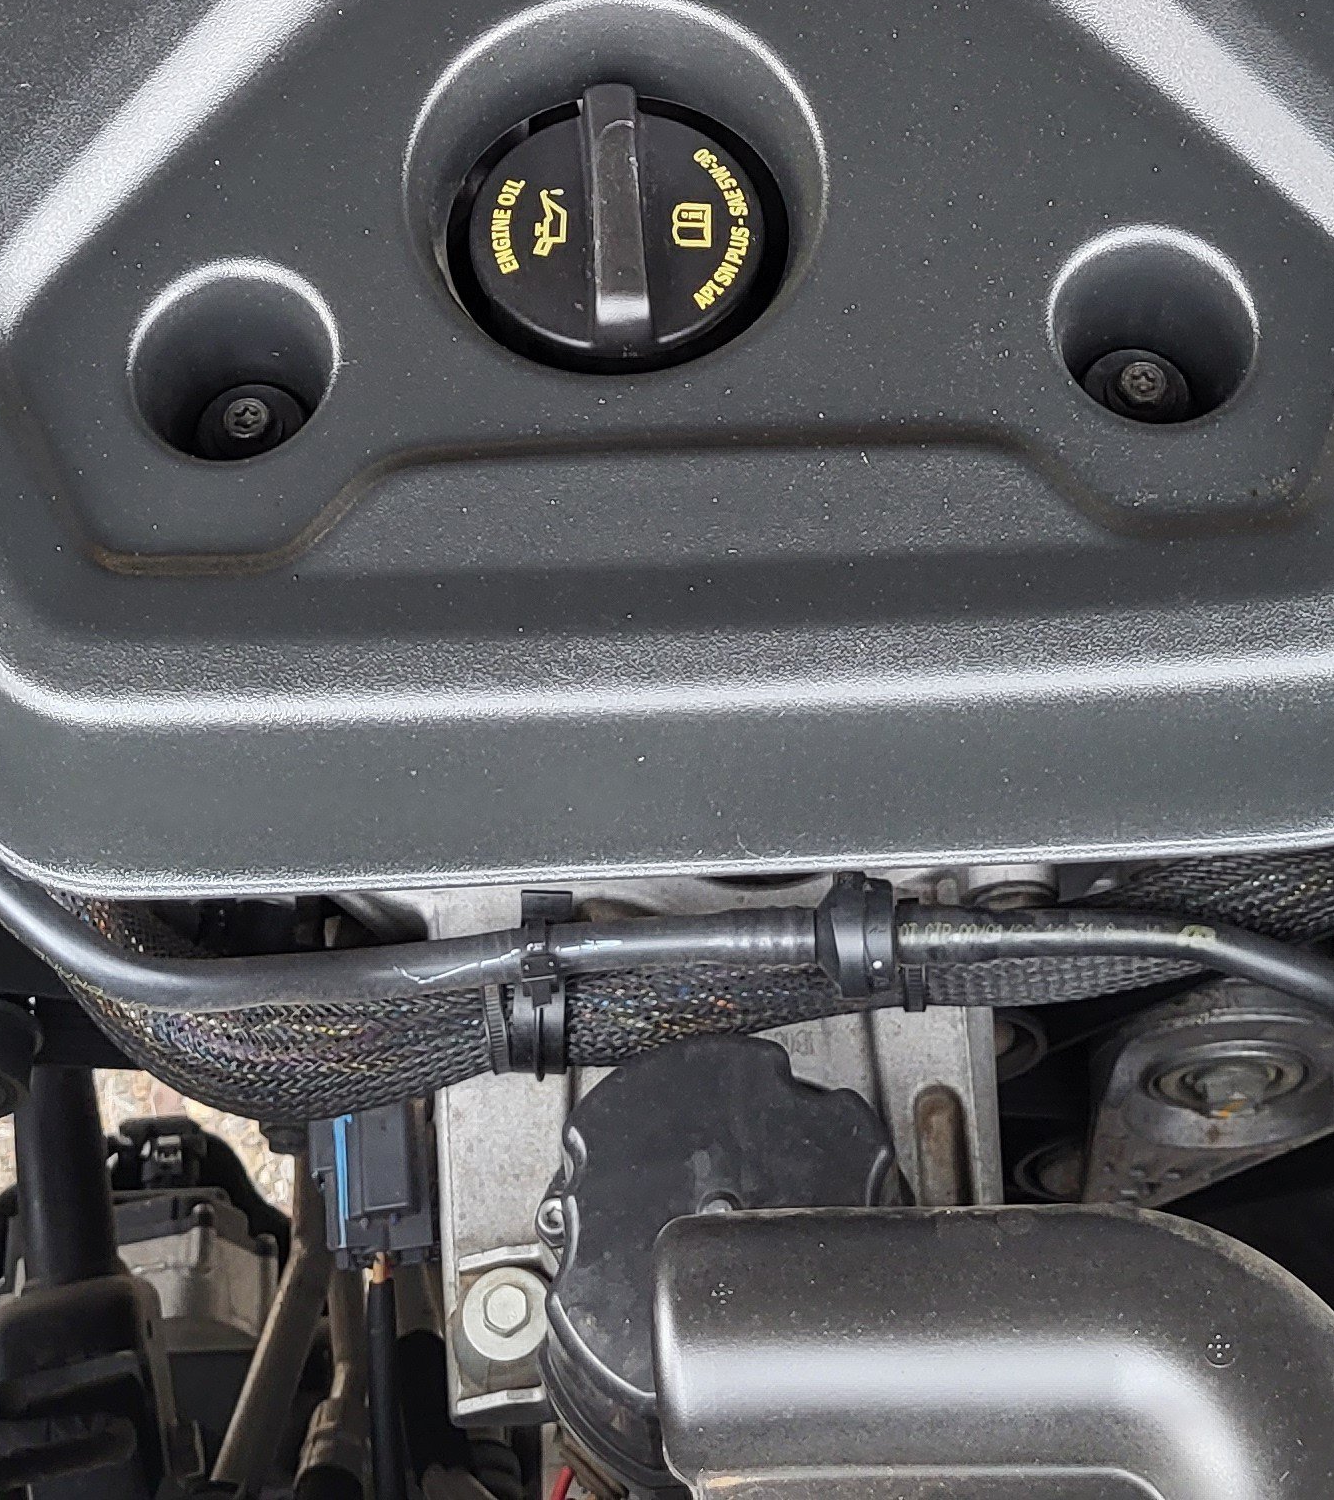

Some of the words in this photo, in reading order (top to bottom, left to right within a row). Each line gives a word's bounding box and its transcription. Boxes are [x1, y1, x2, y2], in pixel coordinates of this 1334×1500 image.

[693, 148, 737, 193] 5W-30
[496, 179, 526, 206] OIL
[723, 188, 749, 217] SAE
[491, 207, 520, 275] ENGINE
[726, 226, 750, 265] PLUS
[713, 261, 739, 288] SN
[692, 280, 724, 311] API
